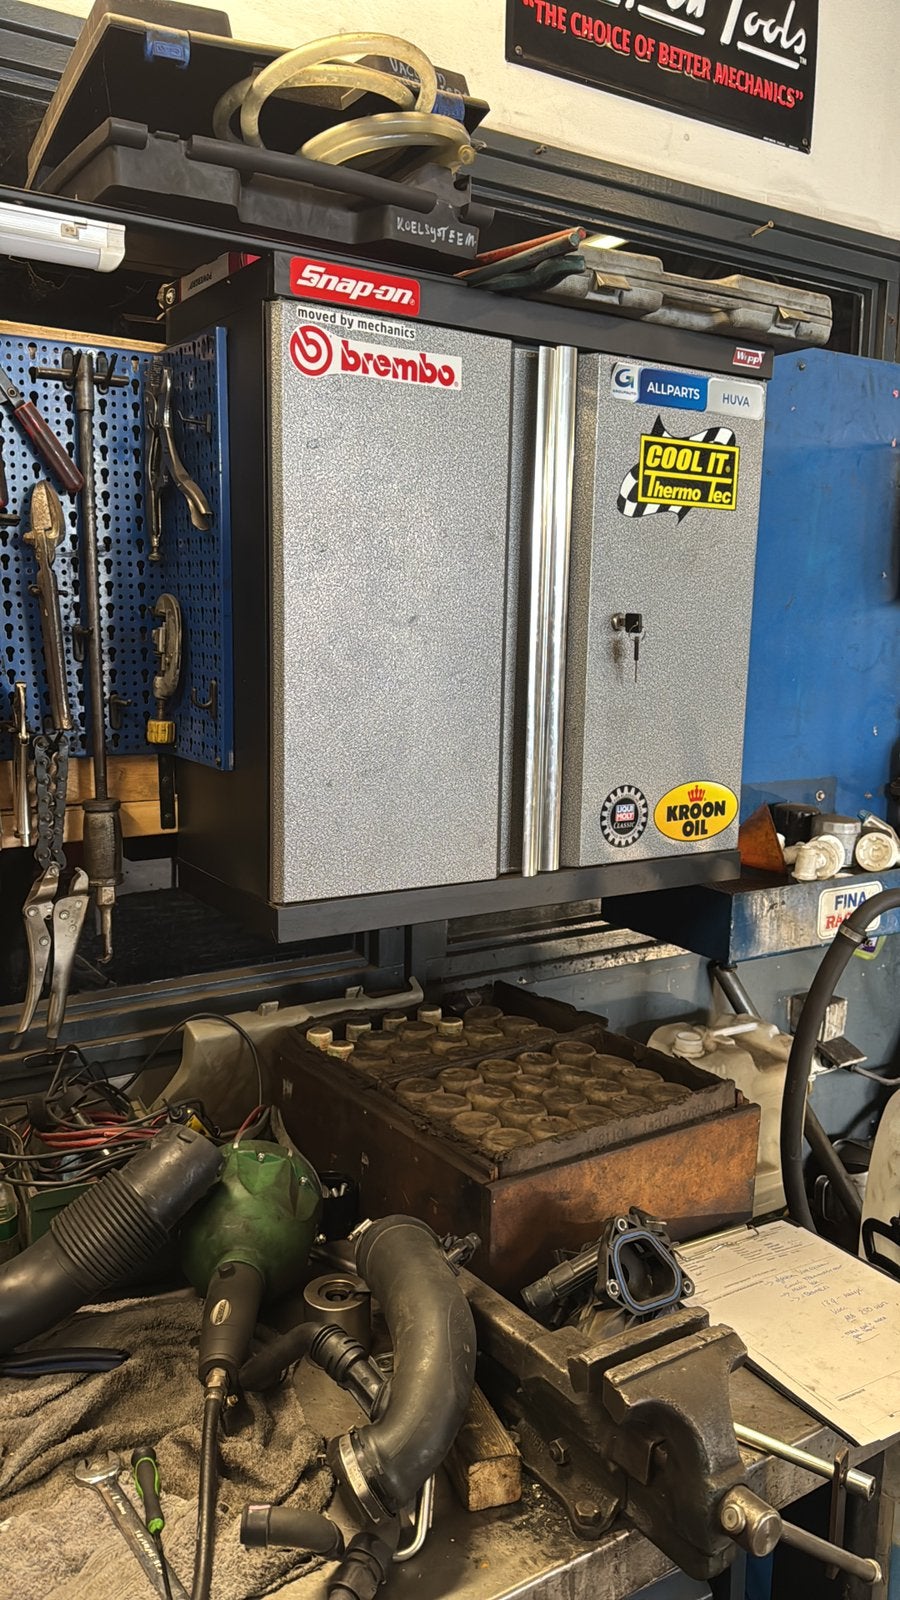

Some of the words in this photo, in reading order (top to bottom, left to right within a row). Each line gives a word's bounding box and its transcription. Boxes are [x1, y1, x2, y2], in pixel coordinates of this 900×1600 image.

[570, 12, 631, 54] CHOICE
[634, 34, 656, 61] OF
[658, 42, 711, 80] BETTER
[297, 307, 336, 324] moved
[340, 315, 354, 329] by
[357, 320, 415, 339] mechanics
[341, 340, 455, 386] brembo
[647, 381, 700, 400] ALLPARTS
[722, 393, 750, 407] HUVA
[646, 445, 702, 473] COOL
[644, 471, 701, 501] Thermo
[707, 478, 732, 504] Tec
[666, 800, 726, 822] KROON
[682, 819, 708, 837] OIL
[834, 891, 867, 911] FINA
